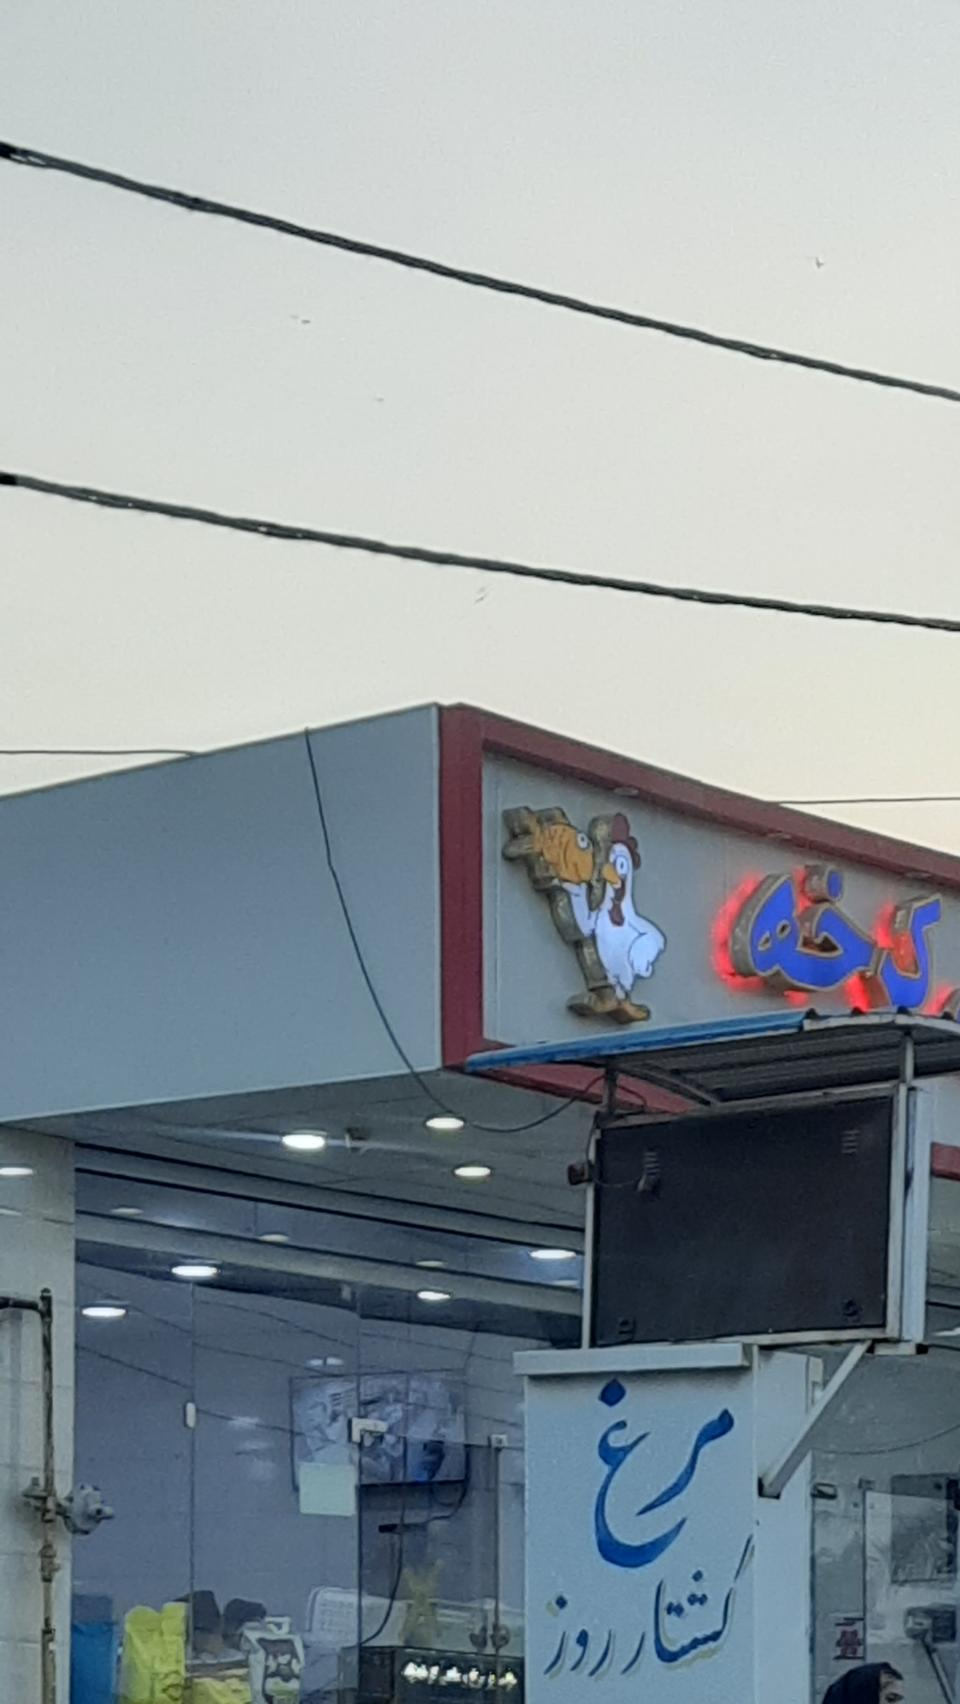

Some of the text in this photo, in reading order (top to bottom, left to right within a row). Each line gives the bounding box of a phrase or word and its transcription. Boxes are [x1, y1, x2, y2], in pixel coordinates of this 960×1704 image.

[594, 1377, 735, 1568] مرغ
[544, 1530, 757, 1678] کشتار روز
